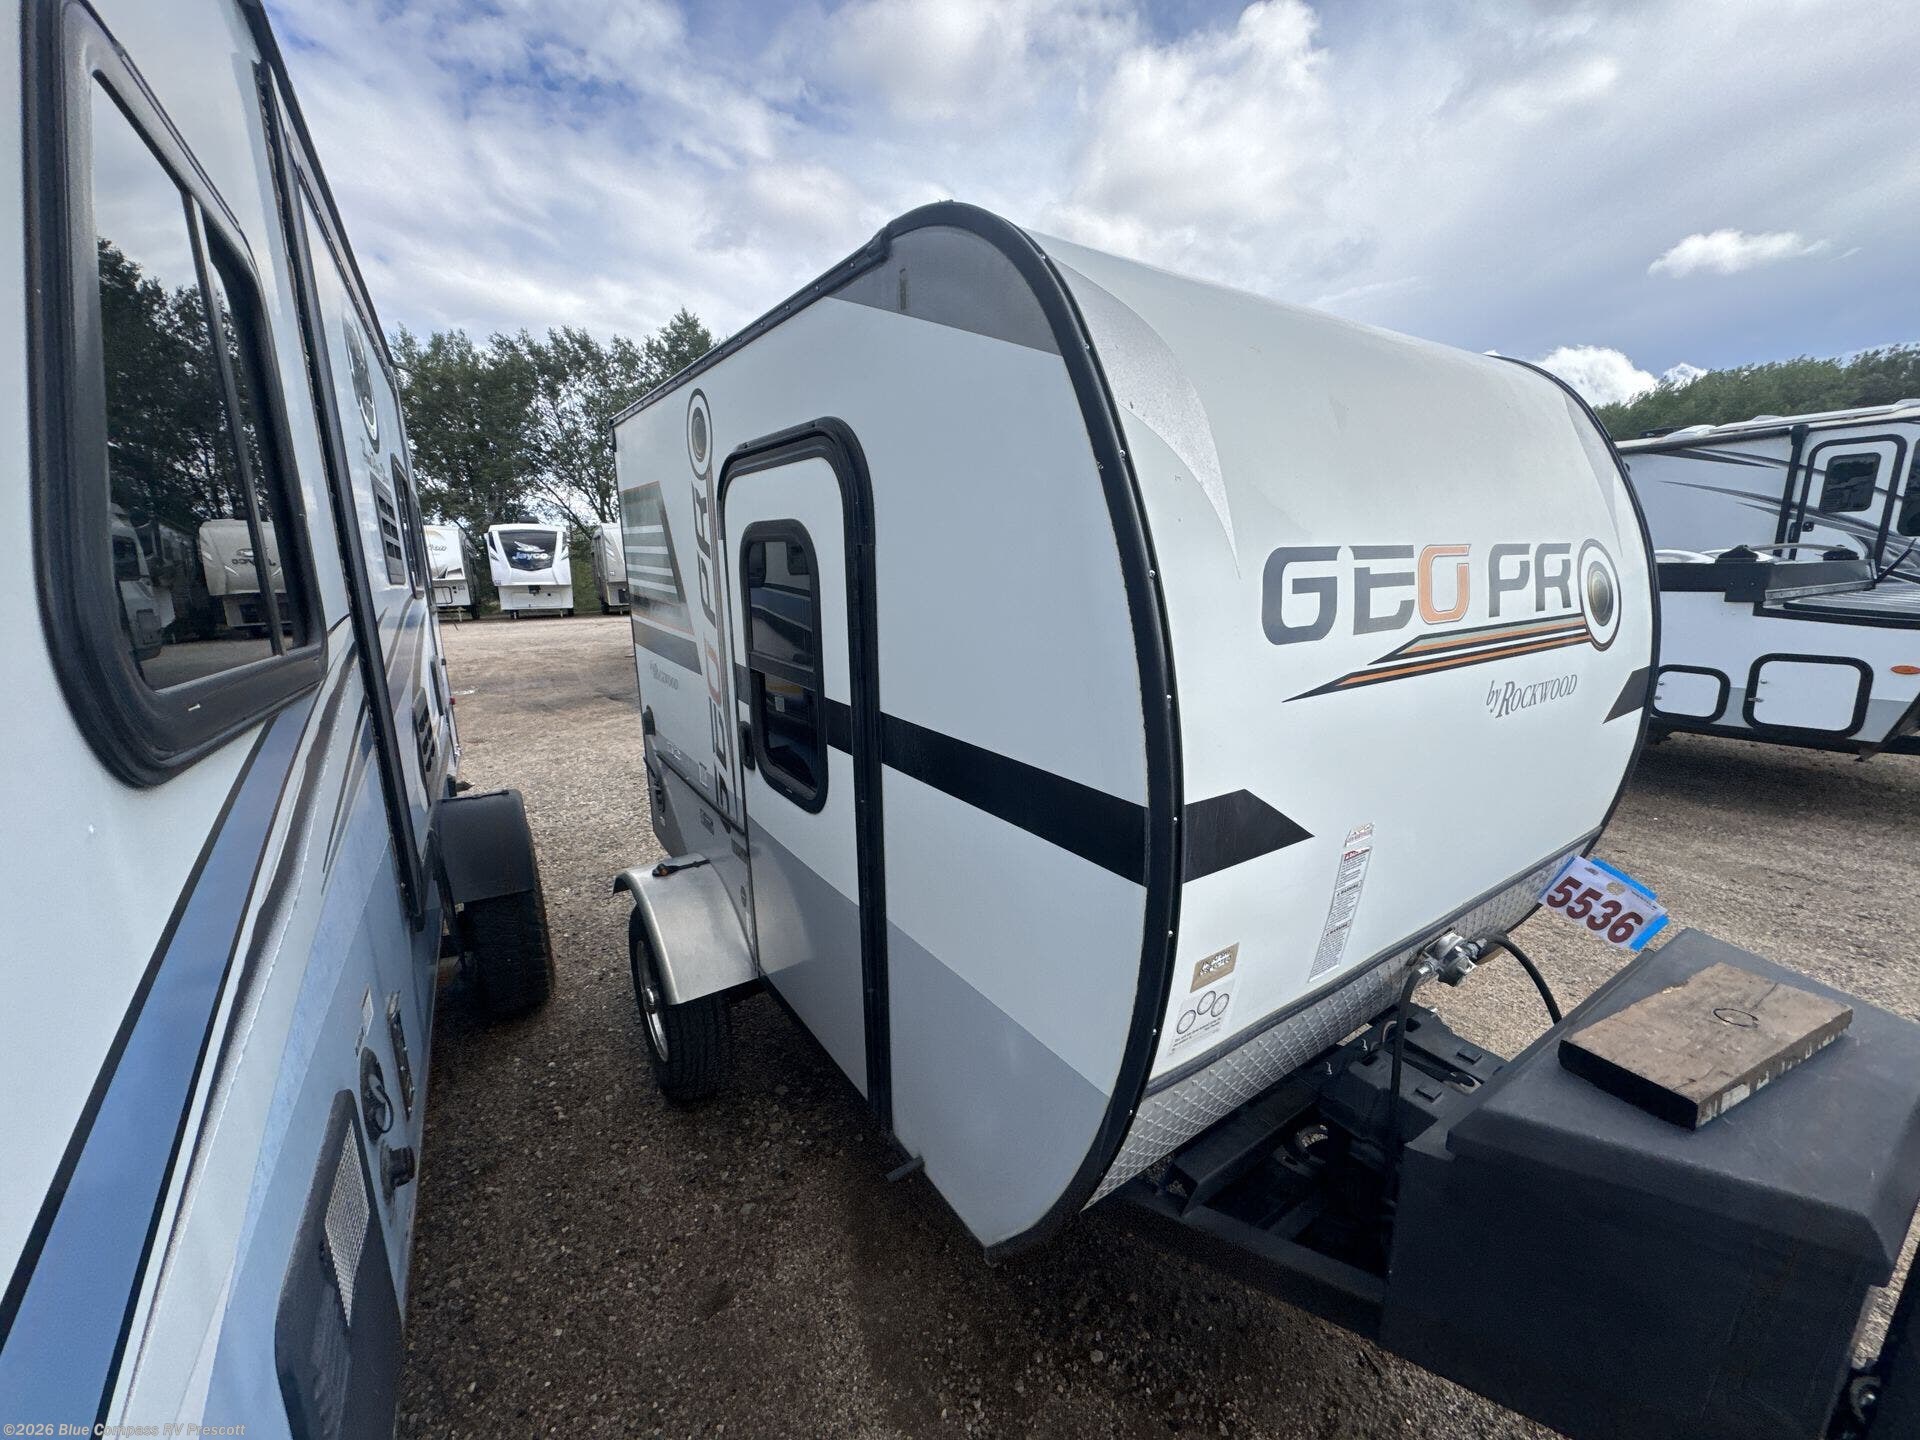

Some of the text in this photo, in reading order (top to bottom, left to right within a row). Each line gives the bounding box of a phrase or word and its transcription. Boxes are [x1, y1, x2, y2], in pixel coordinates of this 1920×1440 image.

[512, 552, 548, 561] Jayco
[1261, 537, 1622, 652] GEO PRO
[1485, 680, 1503, 715] by
[1547, 876, 1643, 943] 5536
